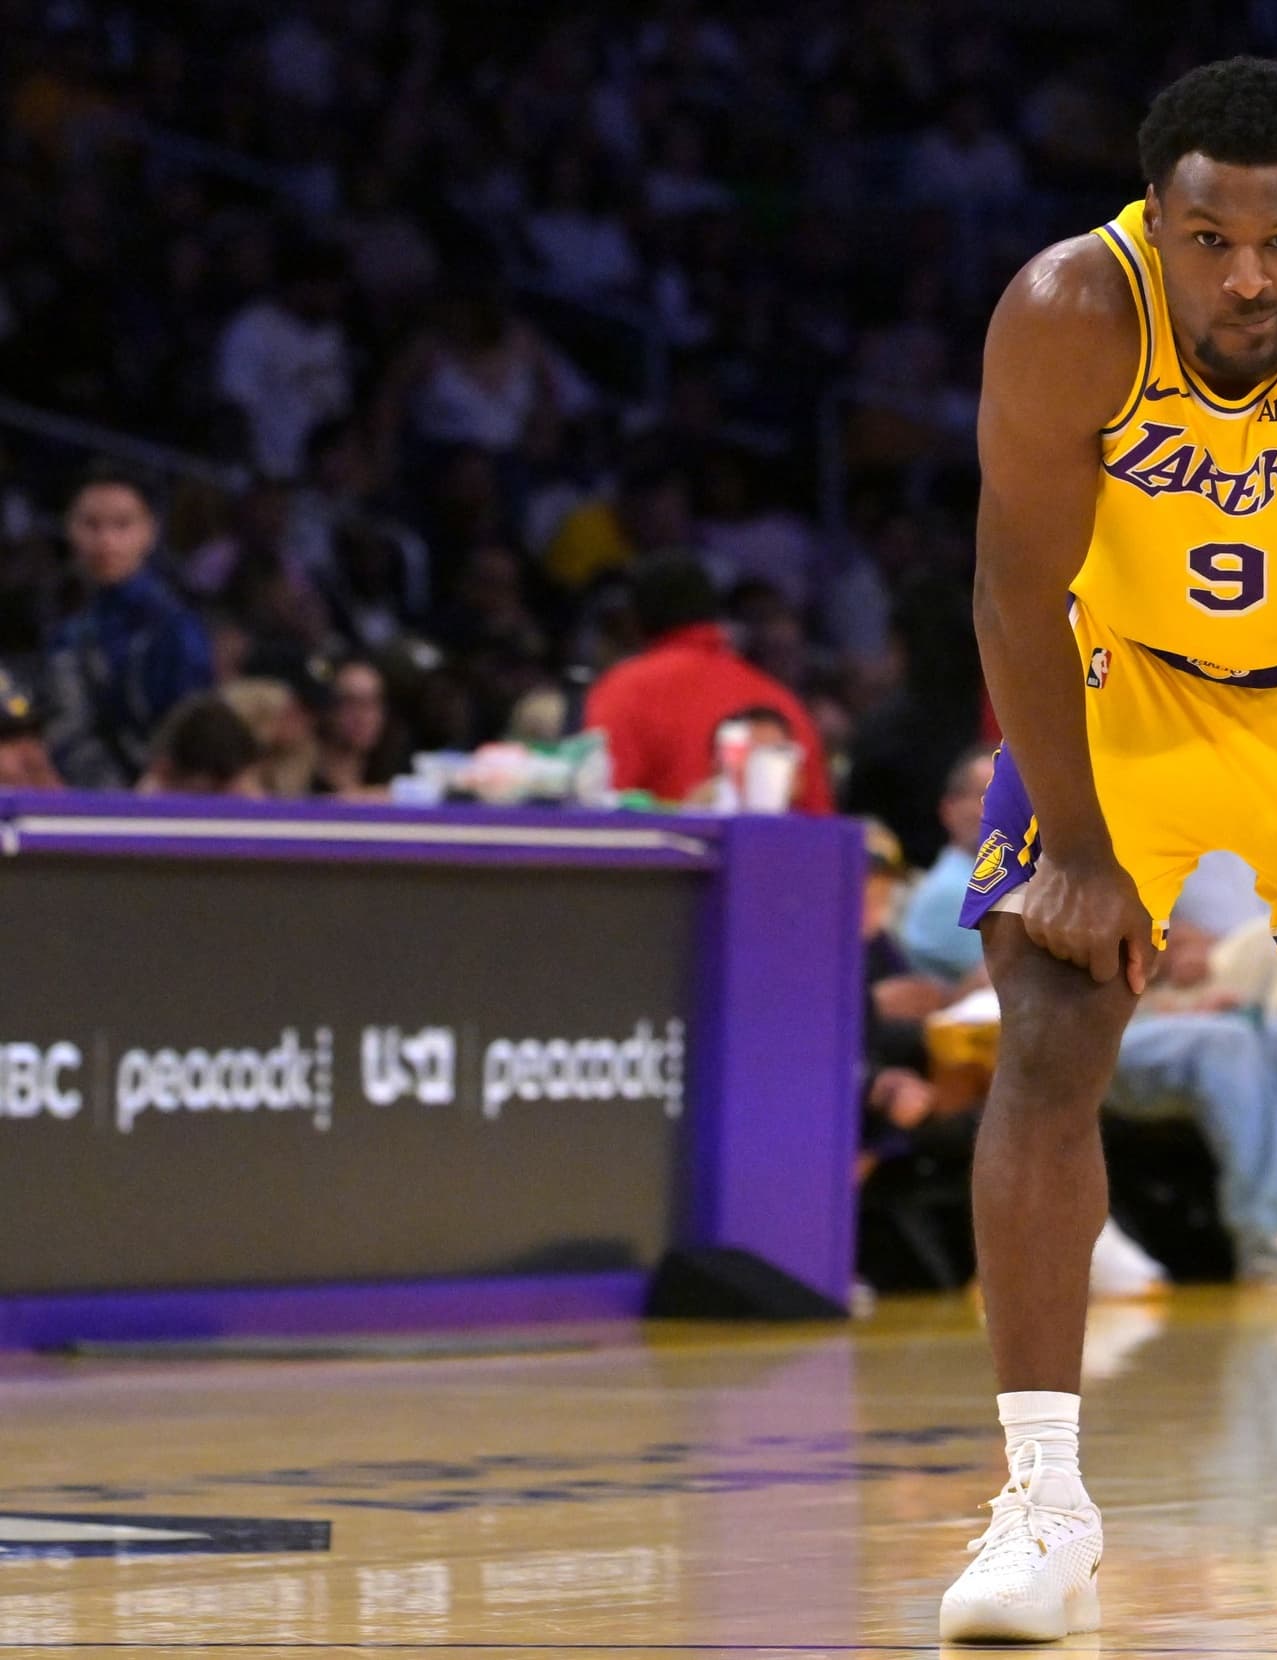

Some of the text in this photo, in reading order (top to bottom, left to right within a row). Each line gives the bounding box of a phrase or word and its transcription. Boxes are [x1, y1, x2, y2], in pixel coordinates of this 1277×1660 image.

[1188, 542, 1266, 616] 9
[0, 1041, 83, 1119] BC
[116, 1026, 312, 1133] peacock
[482, 1017, 666, 1119] peacock
